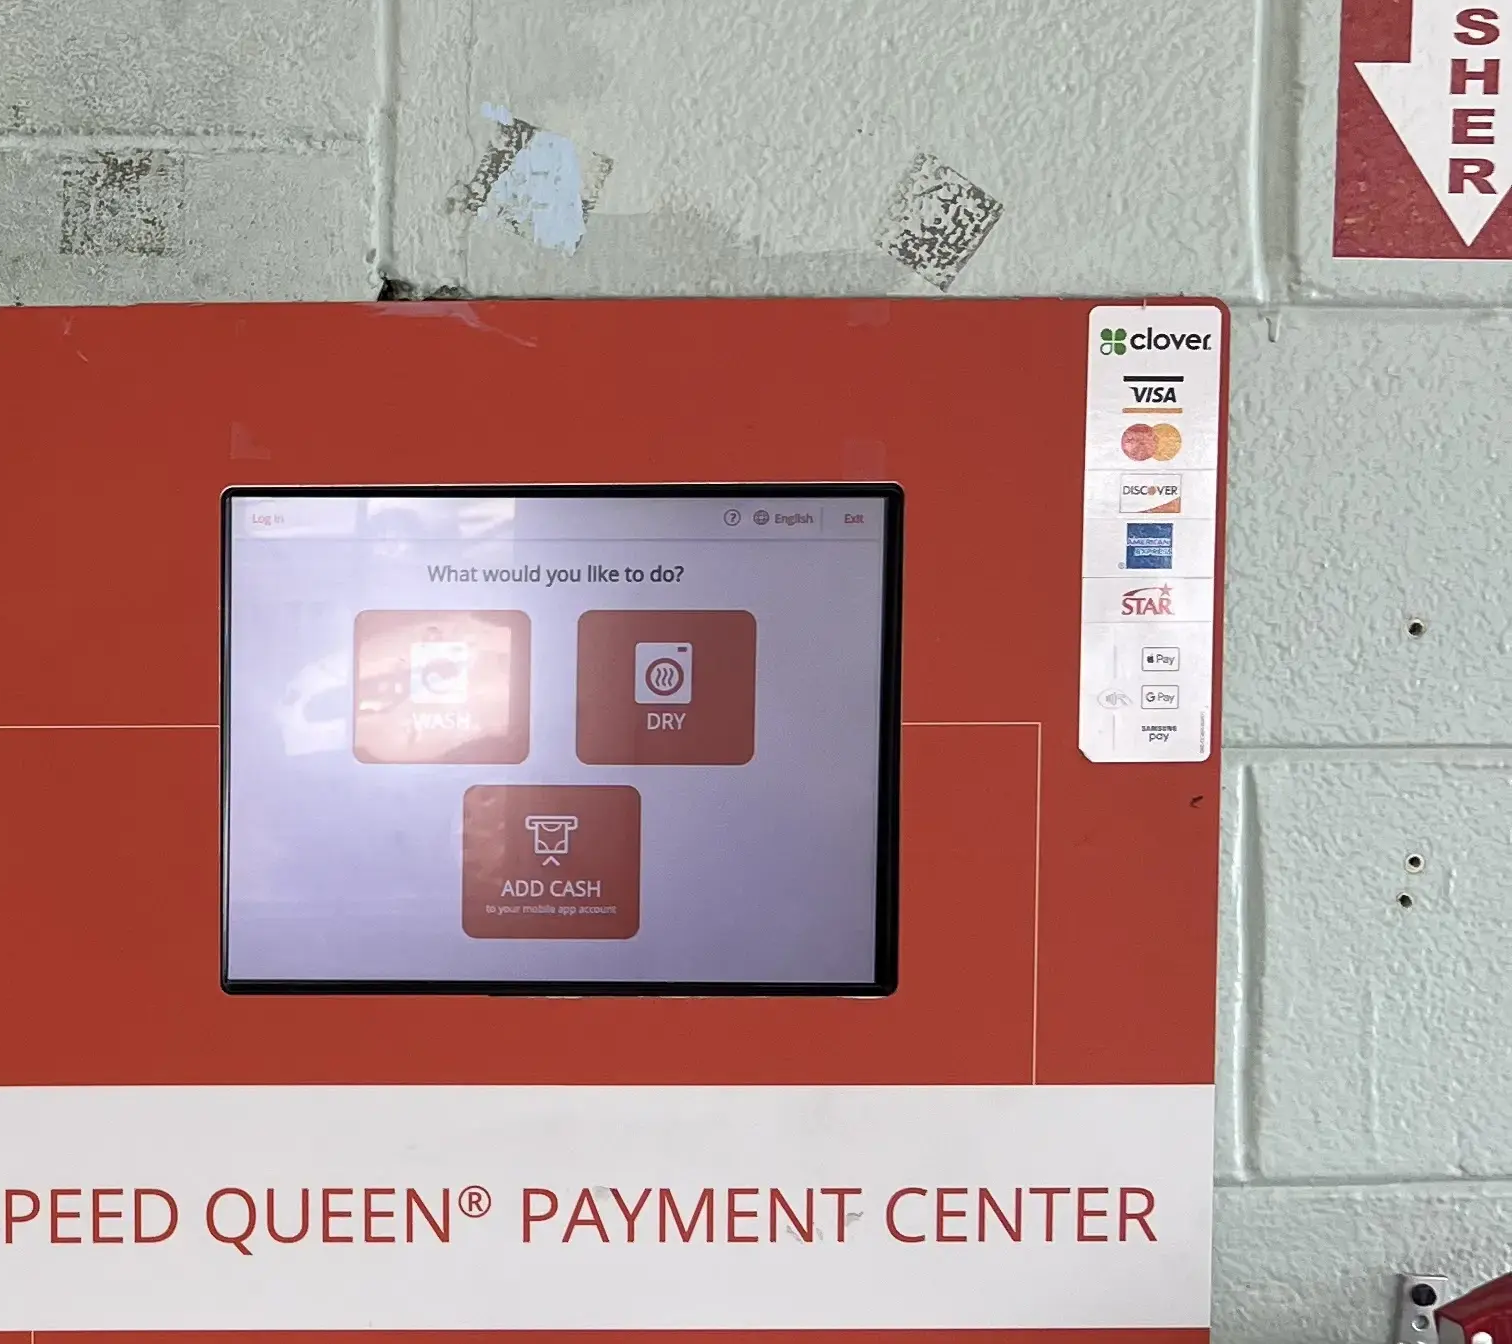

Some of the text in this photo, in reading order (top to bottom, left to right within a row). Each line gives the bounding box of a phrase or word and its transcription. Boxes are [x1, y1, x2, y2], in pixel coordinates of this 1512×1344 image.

[1130, 327, 1211, 350] clover
[1129, 387, 1176, 403] VISA
[1123, 486, 1177, 495] DISCOVER
[775, 513, 813, 526] English
[844, 514, 864, 524] Exit
[427, 565, 684, 587] What would you like to do?
[1122, 598, 1172, 615] STAR
[1156, 654, 1175, 665] Pay
[1158, 692, 1175, 704] Pay
[411, 712, 686, 730] WASH DRY
[1149, 733, 1169, 742] pay
[501, 880, 600, 897] ADD CASH
[486, 905, 496, 914] to
[498, 906, 520, 915] your
[558, 906, 576, 915] app
[523, 1188, 862, 1243] PAYMENT
[886, 1187, 1157, 1243] CENTER
